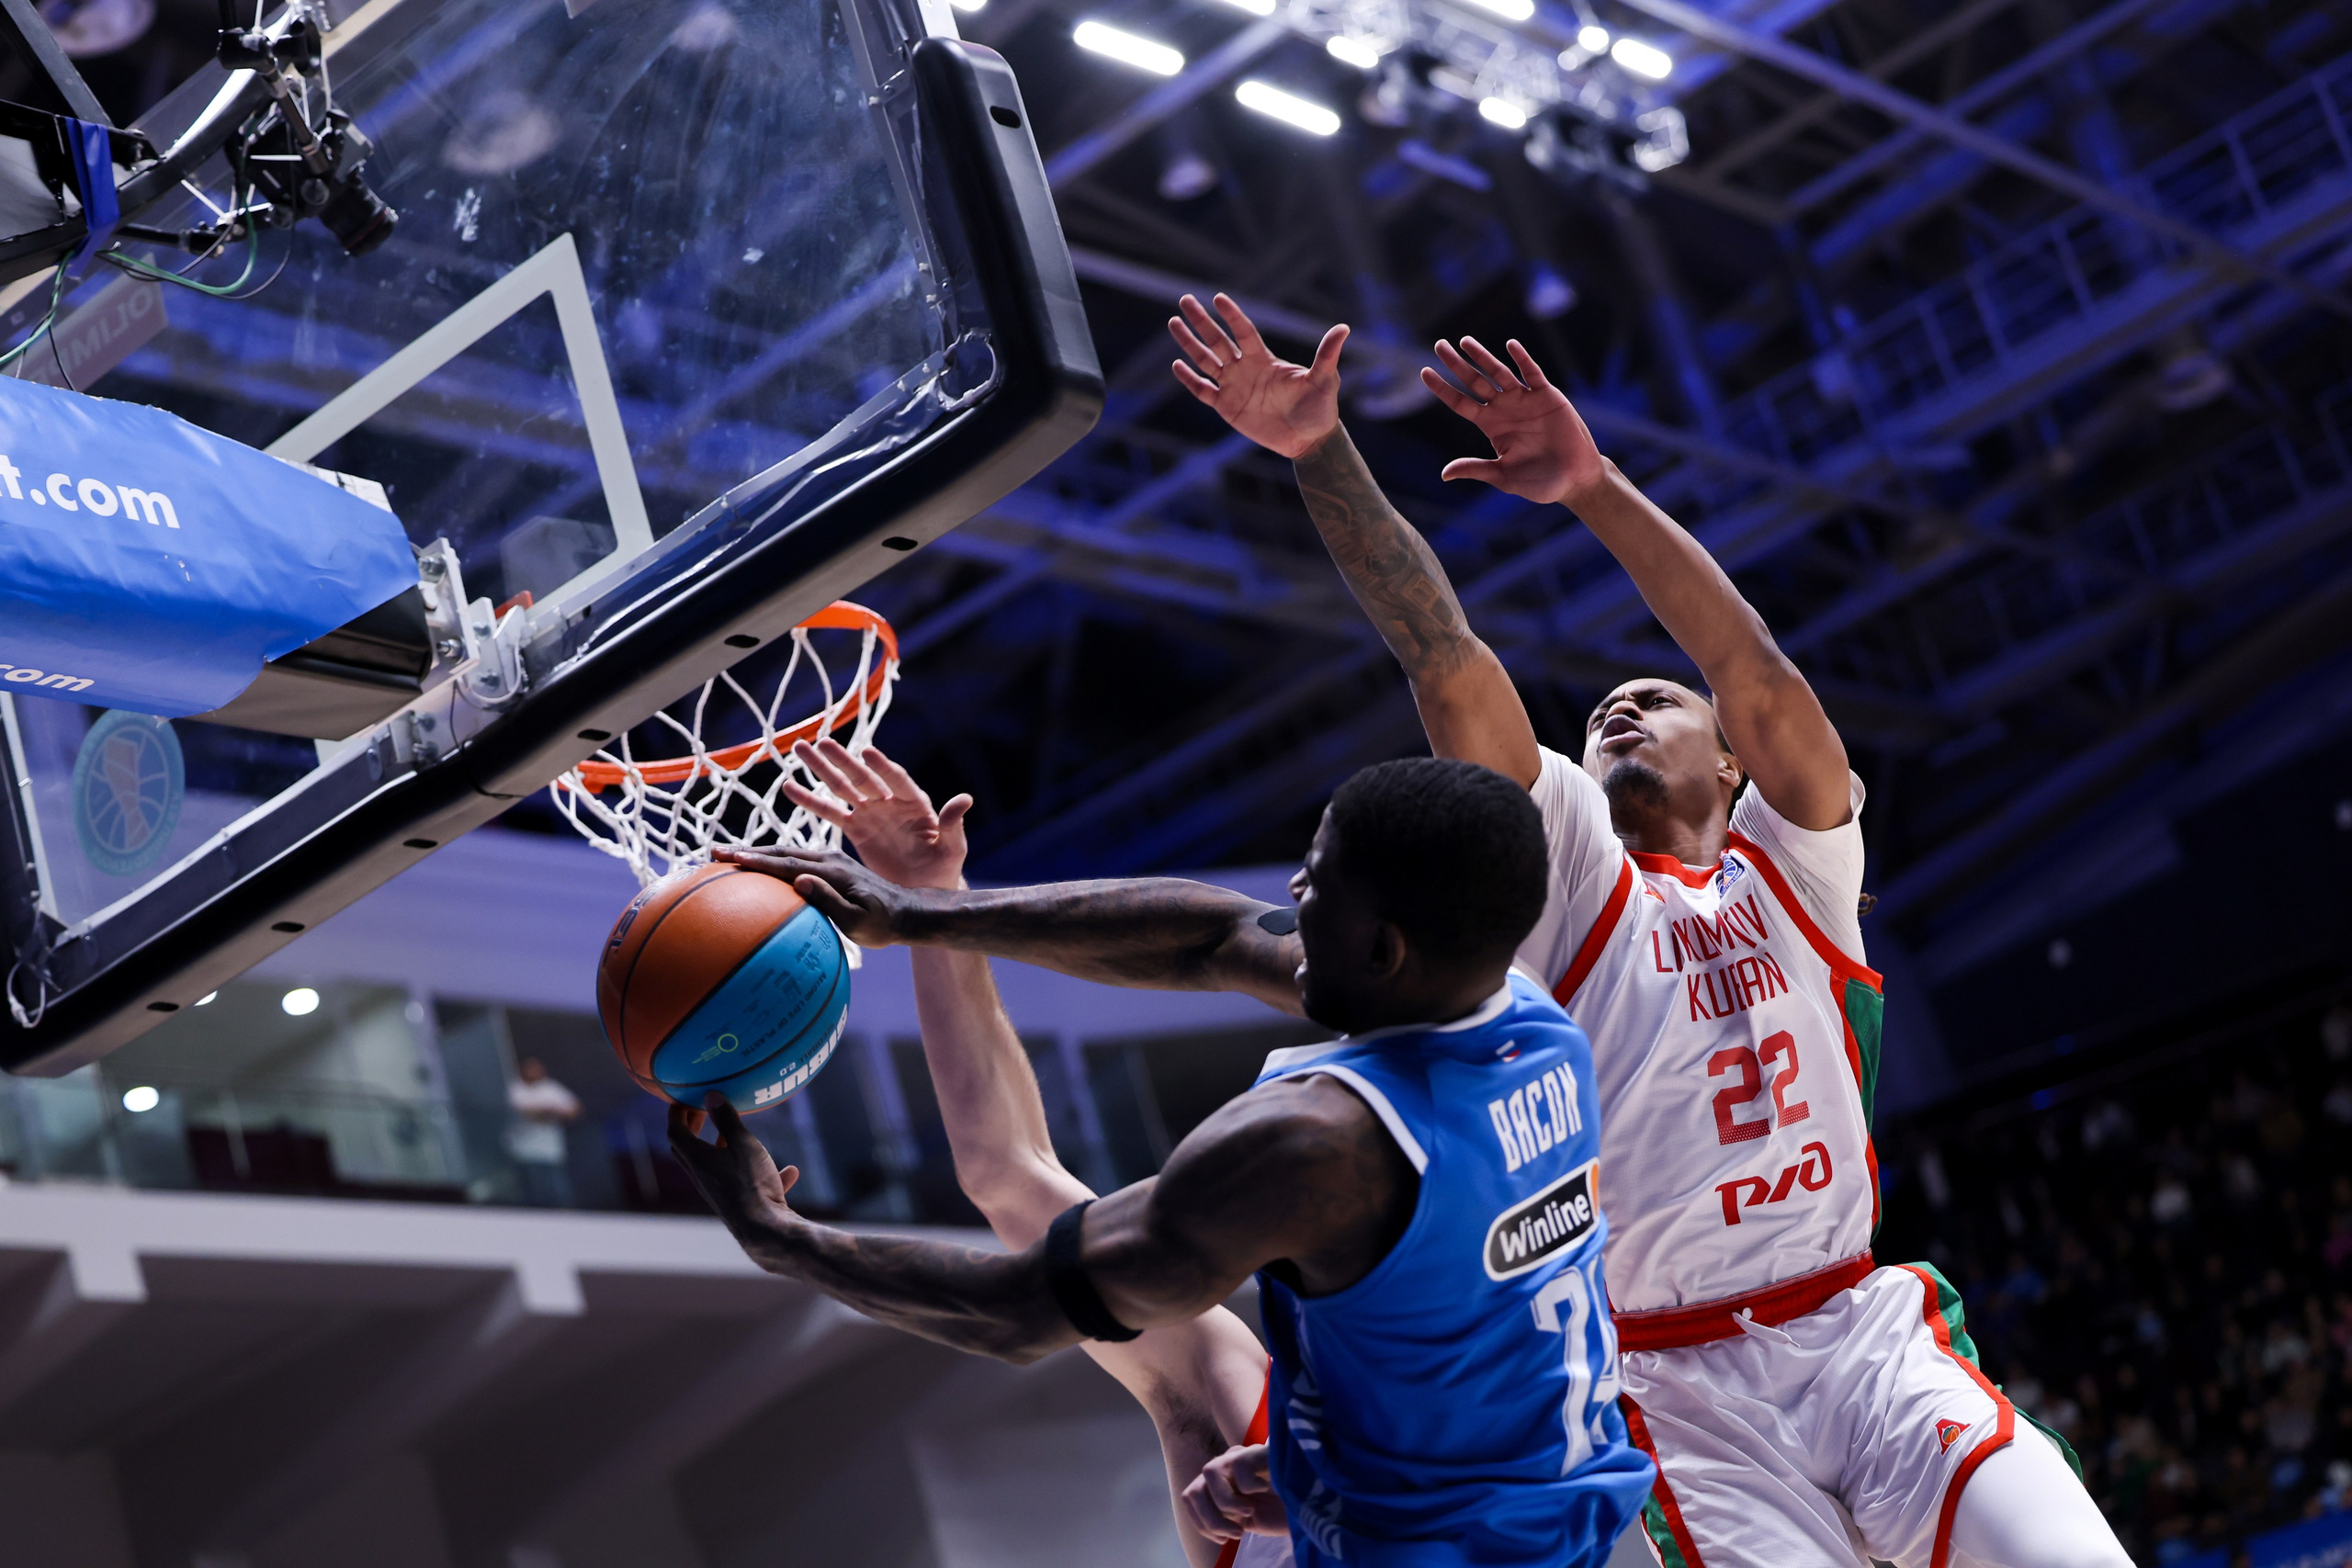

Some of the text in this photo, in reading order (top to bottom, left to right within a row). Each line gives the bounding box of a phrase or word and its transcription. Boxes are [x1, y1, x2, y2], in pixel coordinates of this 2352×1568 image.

[0, 455, 181, 529] t.com
[754, 1003, 848, 1105] SIBUR
[1707, 1030, 1810, 1145] 22
[1487, 1061, 1582, 1173] BACON
[1499, 1194, 1590, 1263] Winline
